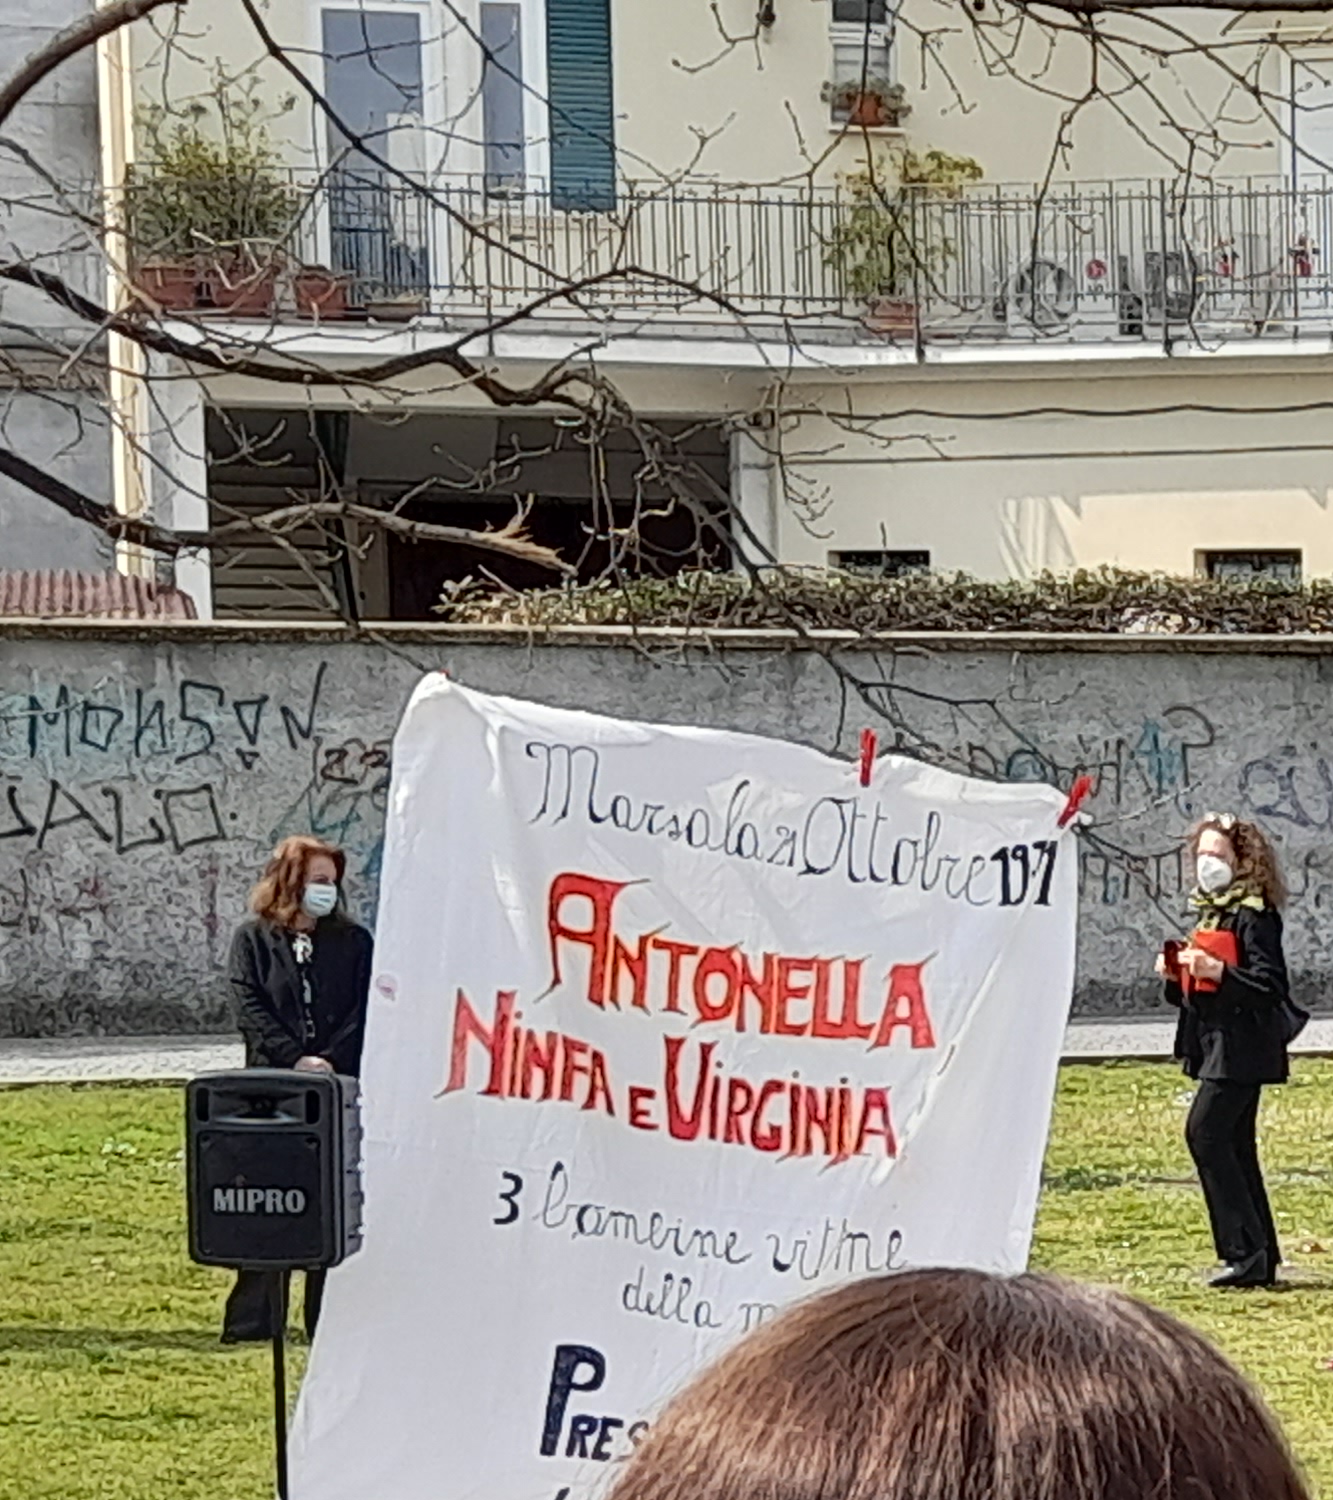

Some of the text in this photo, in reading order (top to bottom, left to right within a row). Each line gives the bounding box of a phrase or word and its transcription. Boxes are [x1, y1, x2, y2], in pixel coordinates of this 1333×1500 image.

[526, 742, 763, 862] Marsala
[797, 796, 993, 906] Ottobre
[536, 872, 937, 1052] ANTONELLA
[435, 988, 616, 1118] NINFA
[663, 1035, 899, 1170] VIRGINIA
[213, 1187, 306, 1214] MIPRO
[493, 1170, 523, 1225] 3
[622, 1264, 723, 1329] della
